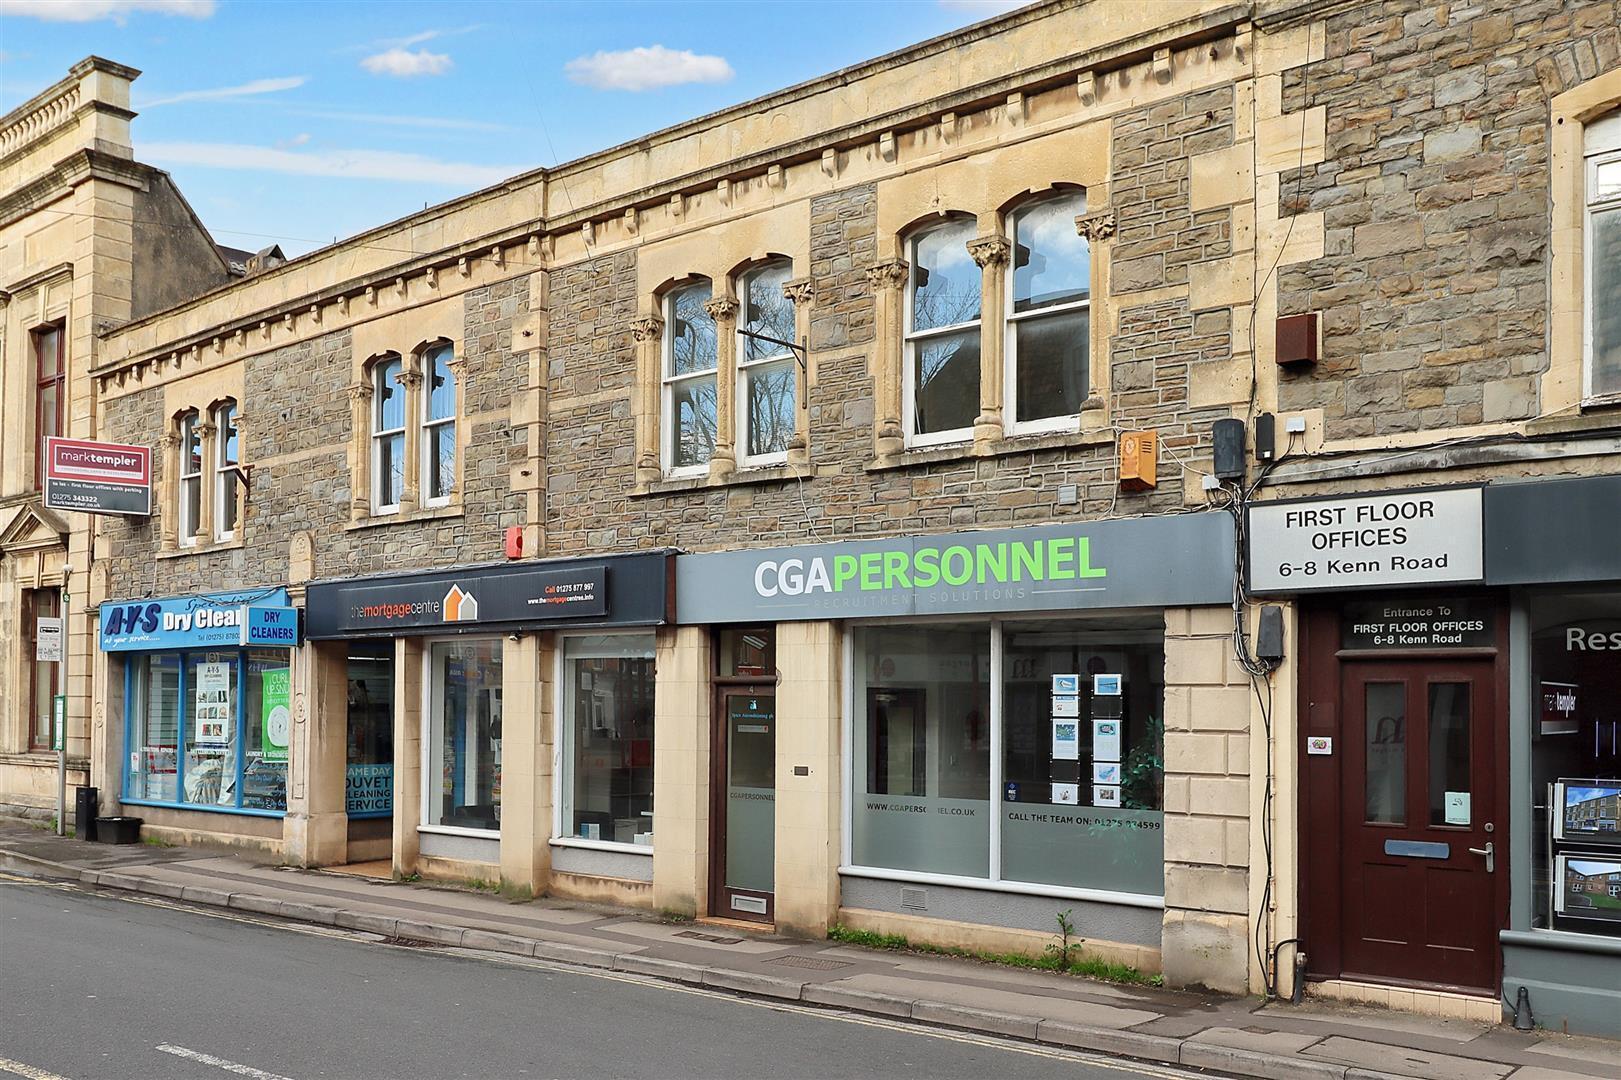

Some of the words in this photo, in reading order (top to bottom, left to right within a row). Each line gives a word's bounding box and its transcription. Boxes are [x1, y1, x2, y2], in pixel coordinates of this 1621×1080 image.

[61, 452, 136, 467] marktempler
[52, 493, 72, 501] 01275
[72, 494, 98, 503] 343322
[1286, 507, 1346, 528] FIRST
[1356, 501, 1434, 523] FLOOR
[1312, 527, 1407, 550] OFFICES
[754, 536, 1107, 597] CGAPERSONNEL
[1279, 561, 1317, 577] 6-8
[1327, 559, 1380, 575] Kenn
[1391, 553, 1448, 571] Road
[556, 584, 573, 593] 01275
[573, 583, 583, 592] 877
[584, 582, 594, 591] 997
[815, 593, 919, 608] RECRUITMENT
[929, 588, 1025, 603] SOLUTIONS
[351, 600, 440, 619] themortgagecentre
[1383, 608, 1433, 618] Entrance
[1438, 606, 1451, 616] To
[163, 611, 193, 632] Dry
[264, 611, 281, 623] DRY
[251, 626, 294, 639] CLEANERS
[1353, 623, 1385, 633] FIRST
[1389, 622, 1428, 632] FLOOR
[1432, 621, 1484, 632] OFFICES
[1373, 635, 1395, 645] 6-8
[1399, 634, 1428, 644] Kenn
[1432, 633, 1462, 644] Road
[1566, 627, 1621, 651] Res
[348, 767, 369, 776] AME
[372, 767, 391, 776] DAY
[346, 777, 391, 788] DUVET
[348, 789, 391, 799] LEANING
[349, 799, 391, 810] ERVICE
[1008, 812, 1029, 821] CALL
[1031, 814, 1048, 822] THE
[1050, 815, 1073, 824] TEAM
[1076, 817, 1091, 825] ON:
